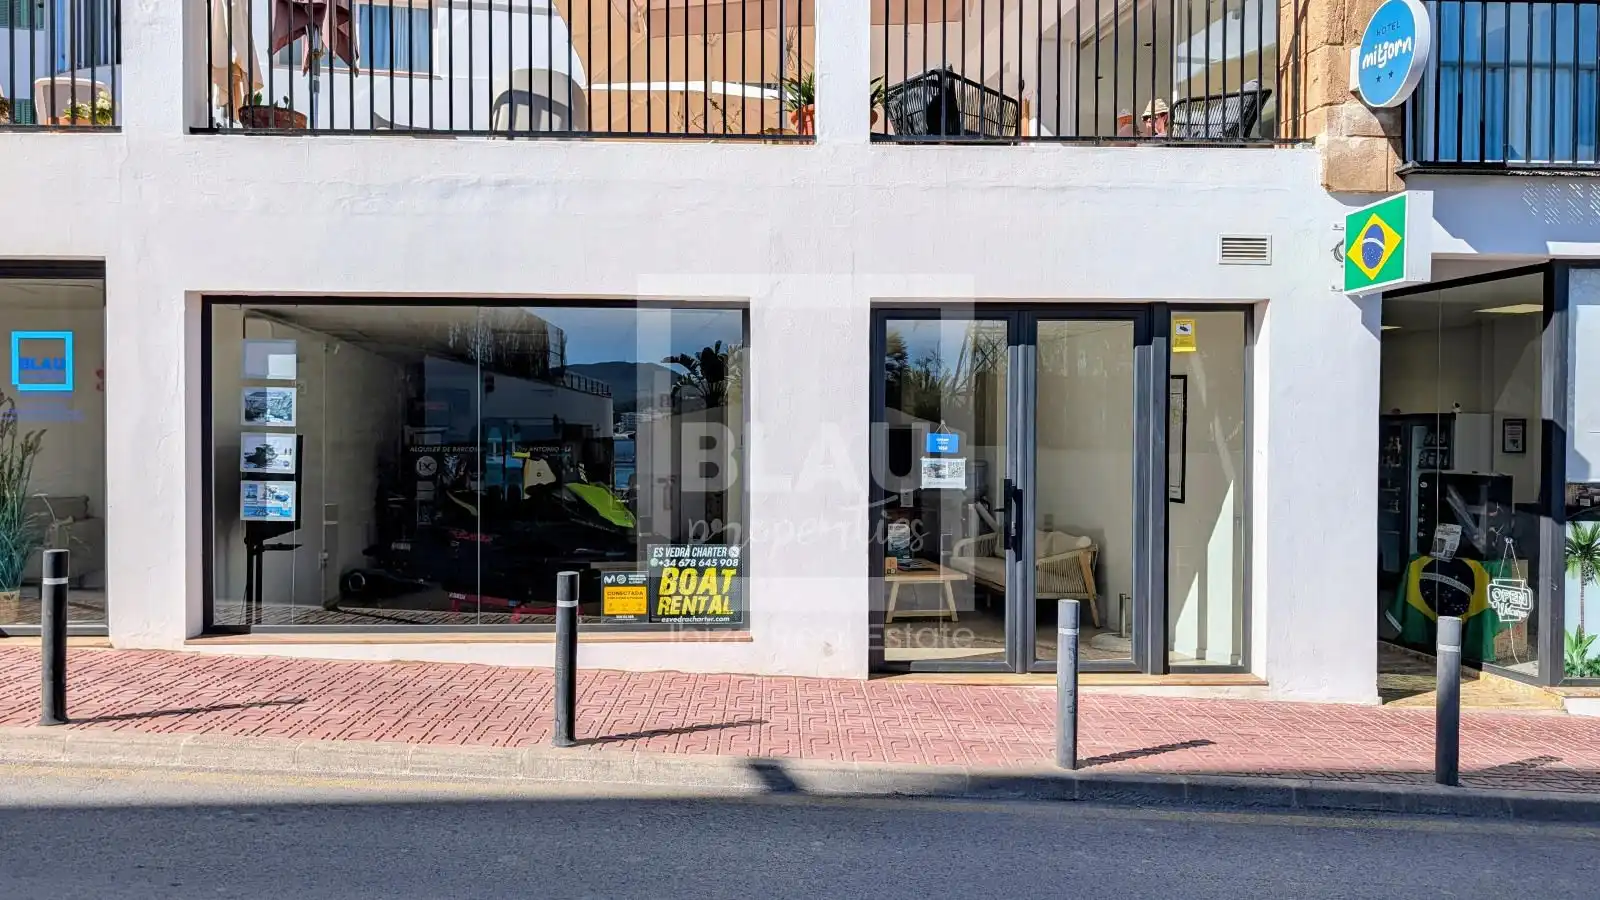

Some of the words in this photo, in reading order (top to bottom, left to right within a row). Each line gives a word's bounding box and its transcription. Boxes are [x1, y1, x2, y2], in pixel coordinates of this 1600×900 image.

[1376, 20, 1401, 36] HOTEL
[19, 357, 66, 370] BLAU
[653, 547, 664, 558] ES
[692, 547, 727, 558] CHARTER
[659, 559, 676, 567] +34
[678, 559, 696, 567] 678
[698, 559, 717, 567] 645
[720, 559, 738, 567] 908
[659, 567, 737, 595] BOAT
[1491, 587, 1528, 606] OPEN
[657, 595, 734, 615] RENTAL
